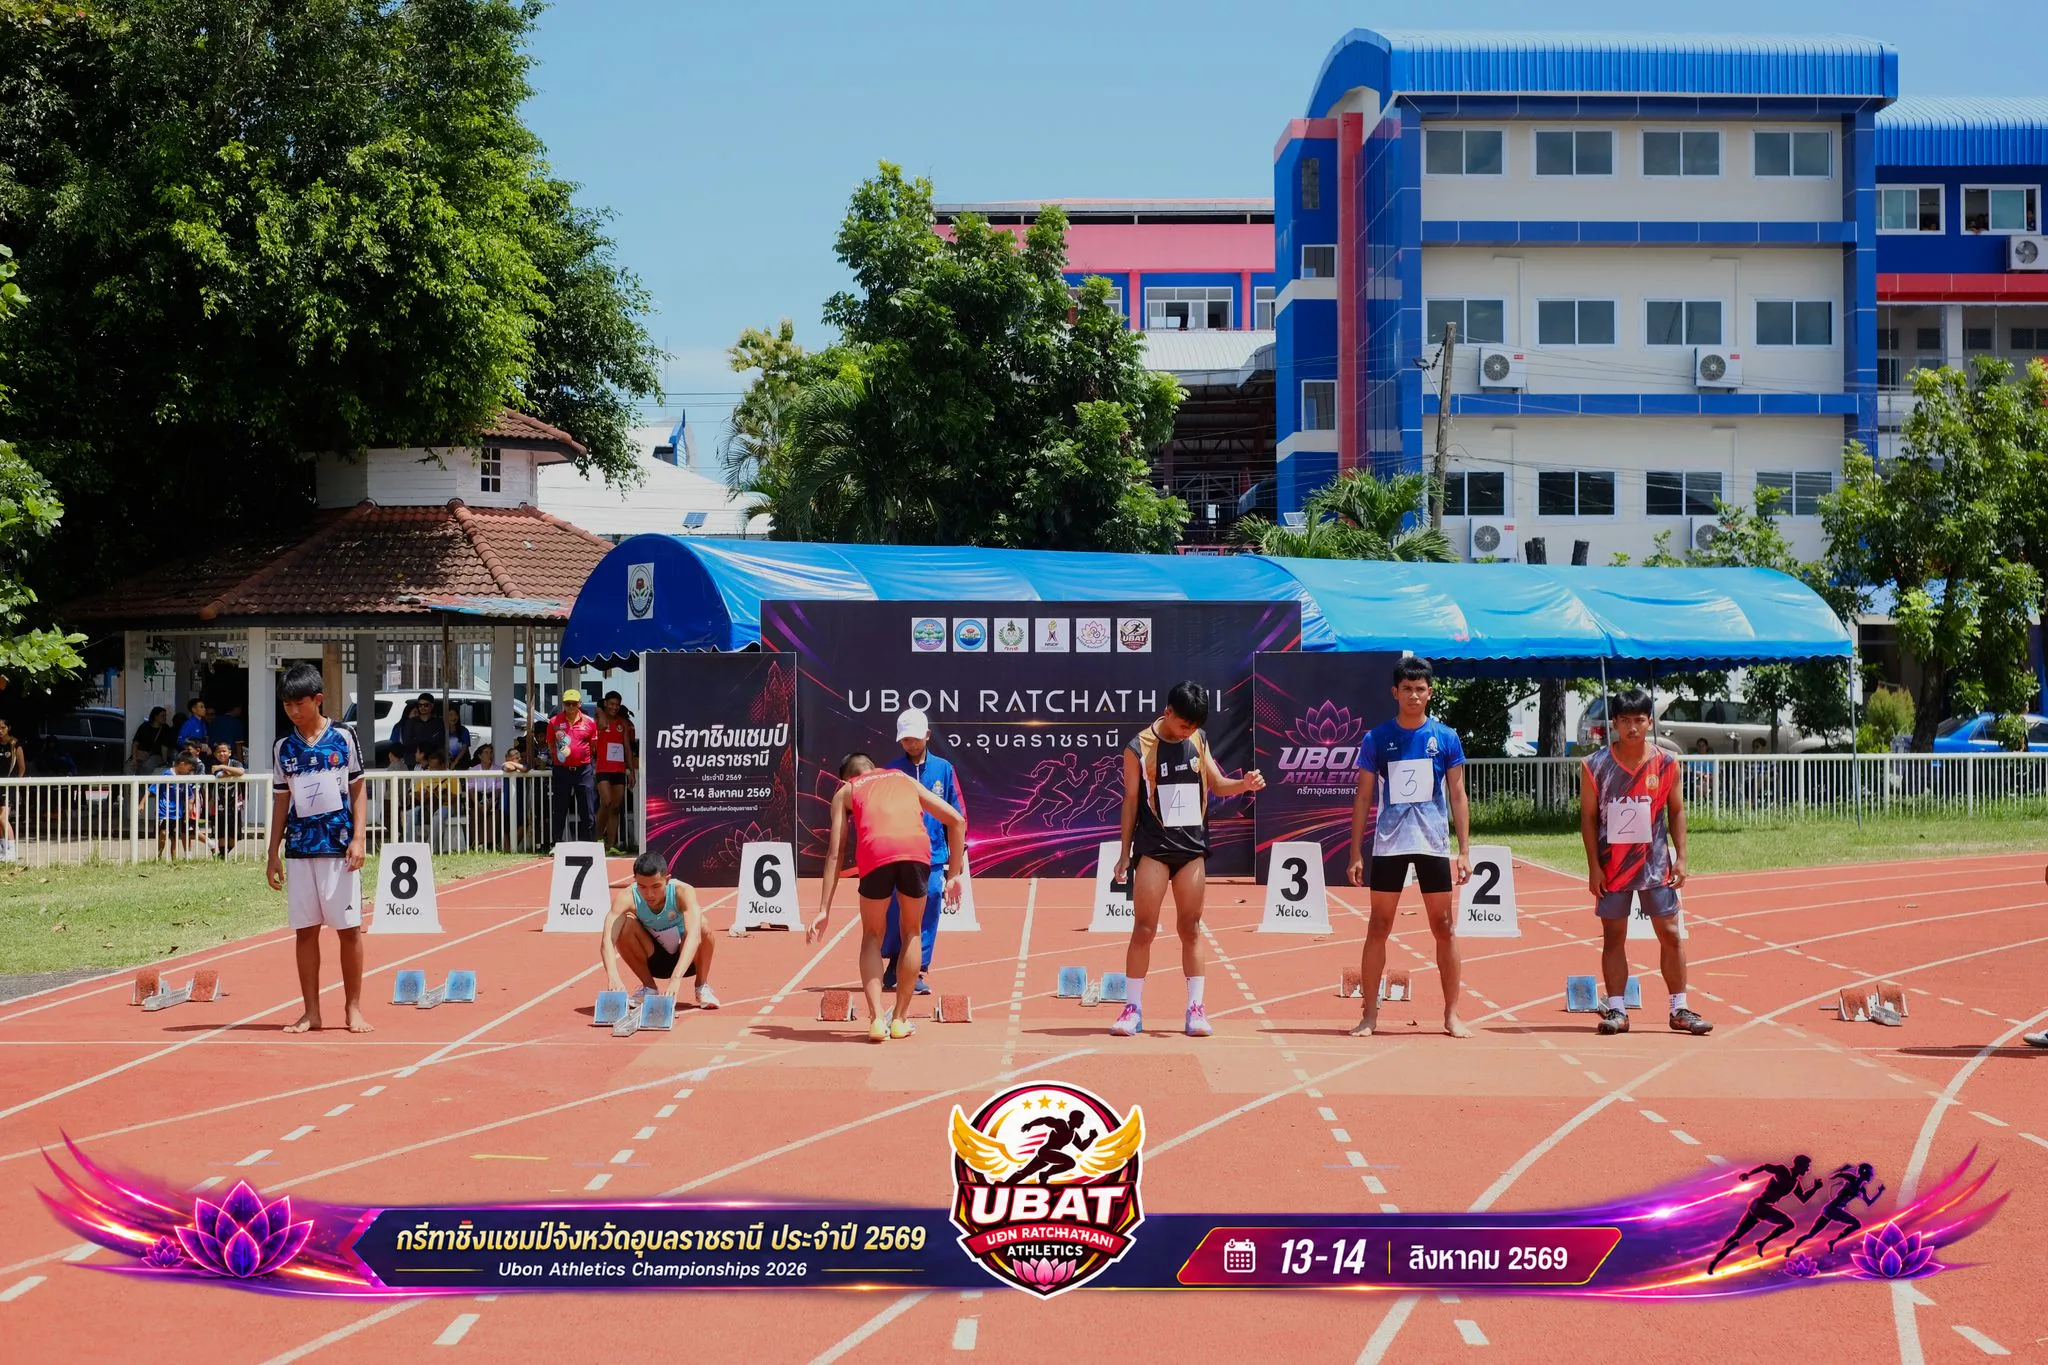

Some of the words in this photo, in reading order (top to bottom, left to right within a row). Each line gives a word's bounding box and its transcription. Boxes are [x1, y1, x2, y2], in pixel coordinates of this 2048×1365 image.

[848, 689, 959, 713] UBON
[980, 689, 1221, 713] RATCHATHI
[947, 729, 1121, 754] จ.อุบลราชธานี
[672, 749, 770, 772] จ.อุบลราชธานี
[303, 782, 324, 807] 7
[708, 787, 744, 798] สิงหาคม
[746, 787, 771, 798] 2569
[1399, 769, 1418, 797] 3
[1170, 790, 1186, 816] 4
[1617, 808, 1637, 835] 2
[390, 855, 419, 900] 8
[565, 855, 594, 900] 7
[753, 854, 782, 899] 6
[1110, 862, 1134, 901] 4
[1280, 857, 1309, 902] 3
[1472, 861, 1501, 905] 2
[386, 903, 420, 916] Nelco
[560, 903, 594, 916] Nelco
[749, 901, 782, 914] Nelco
[1275, 903, 1309, 918] Nelco
[1467, 908, 1502, 922] Nelco
